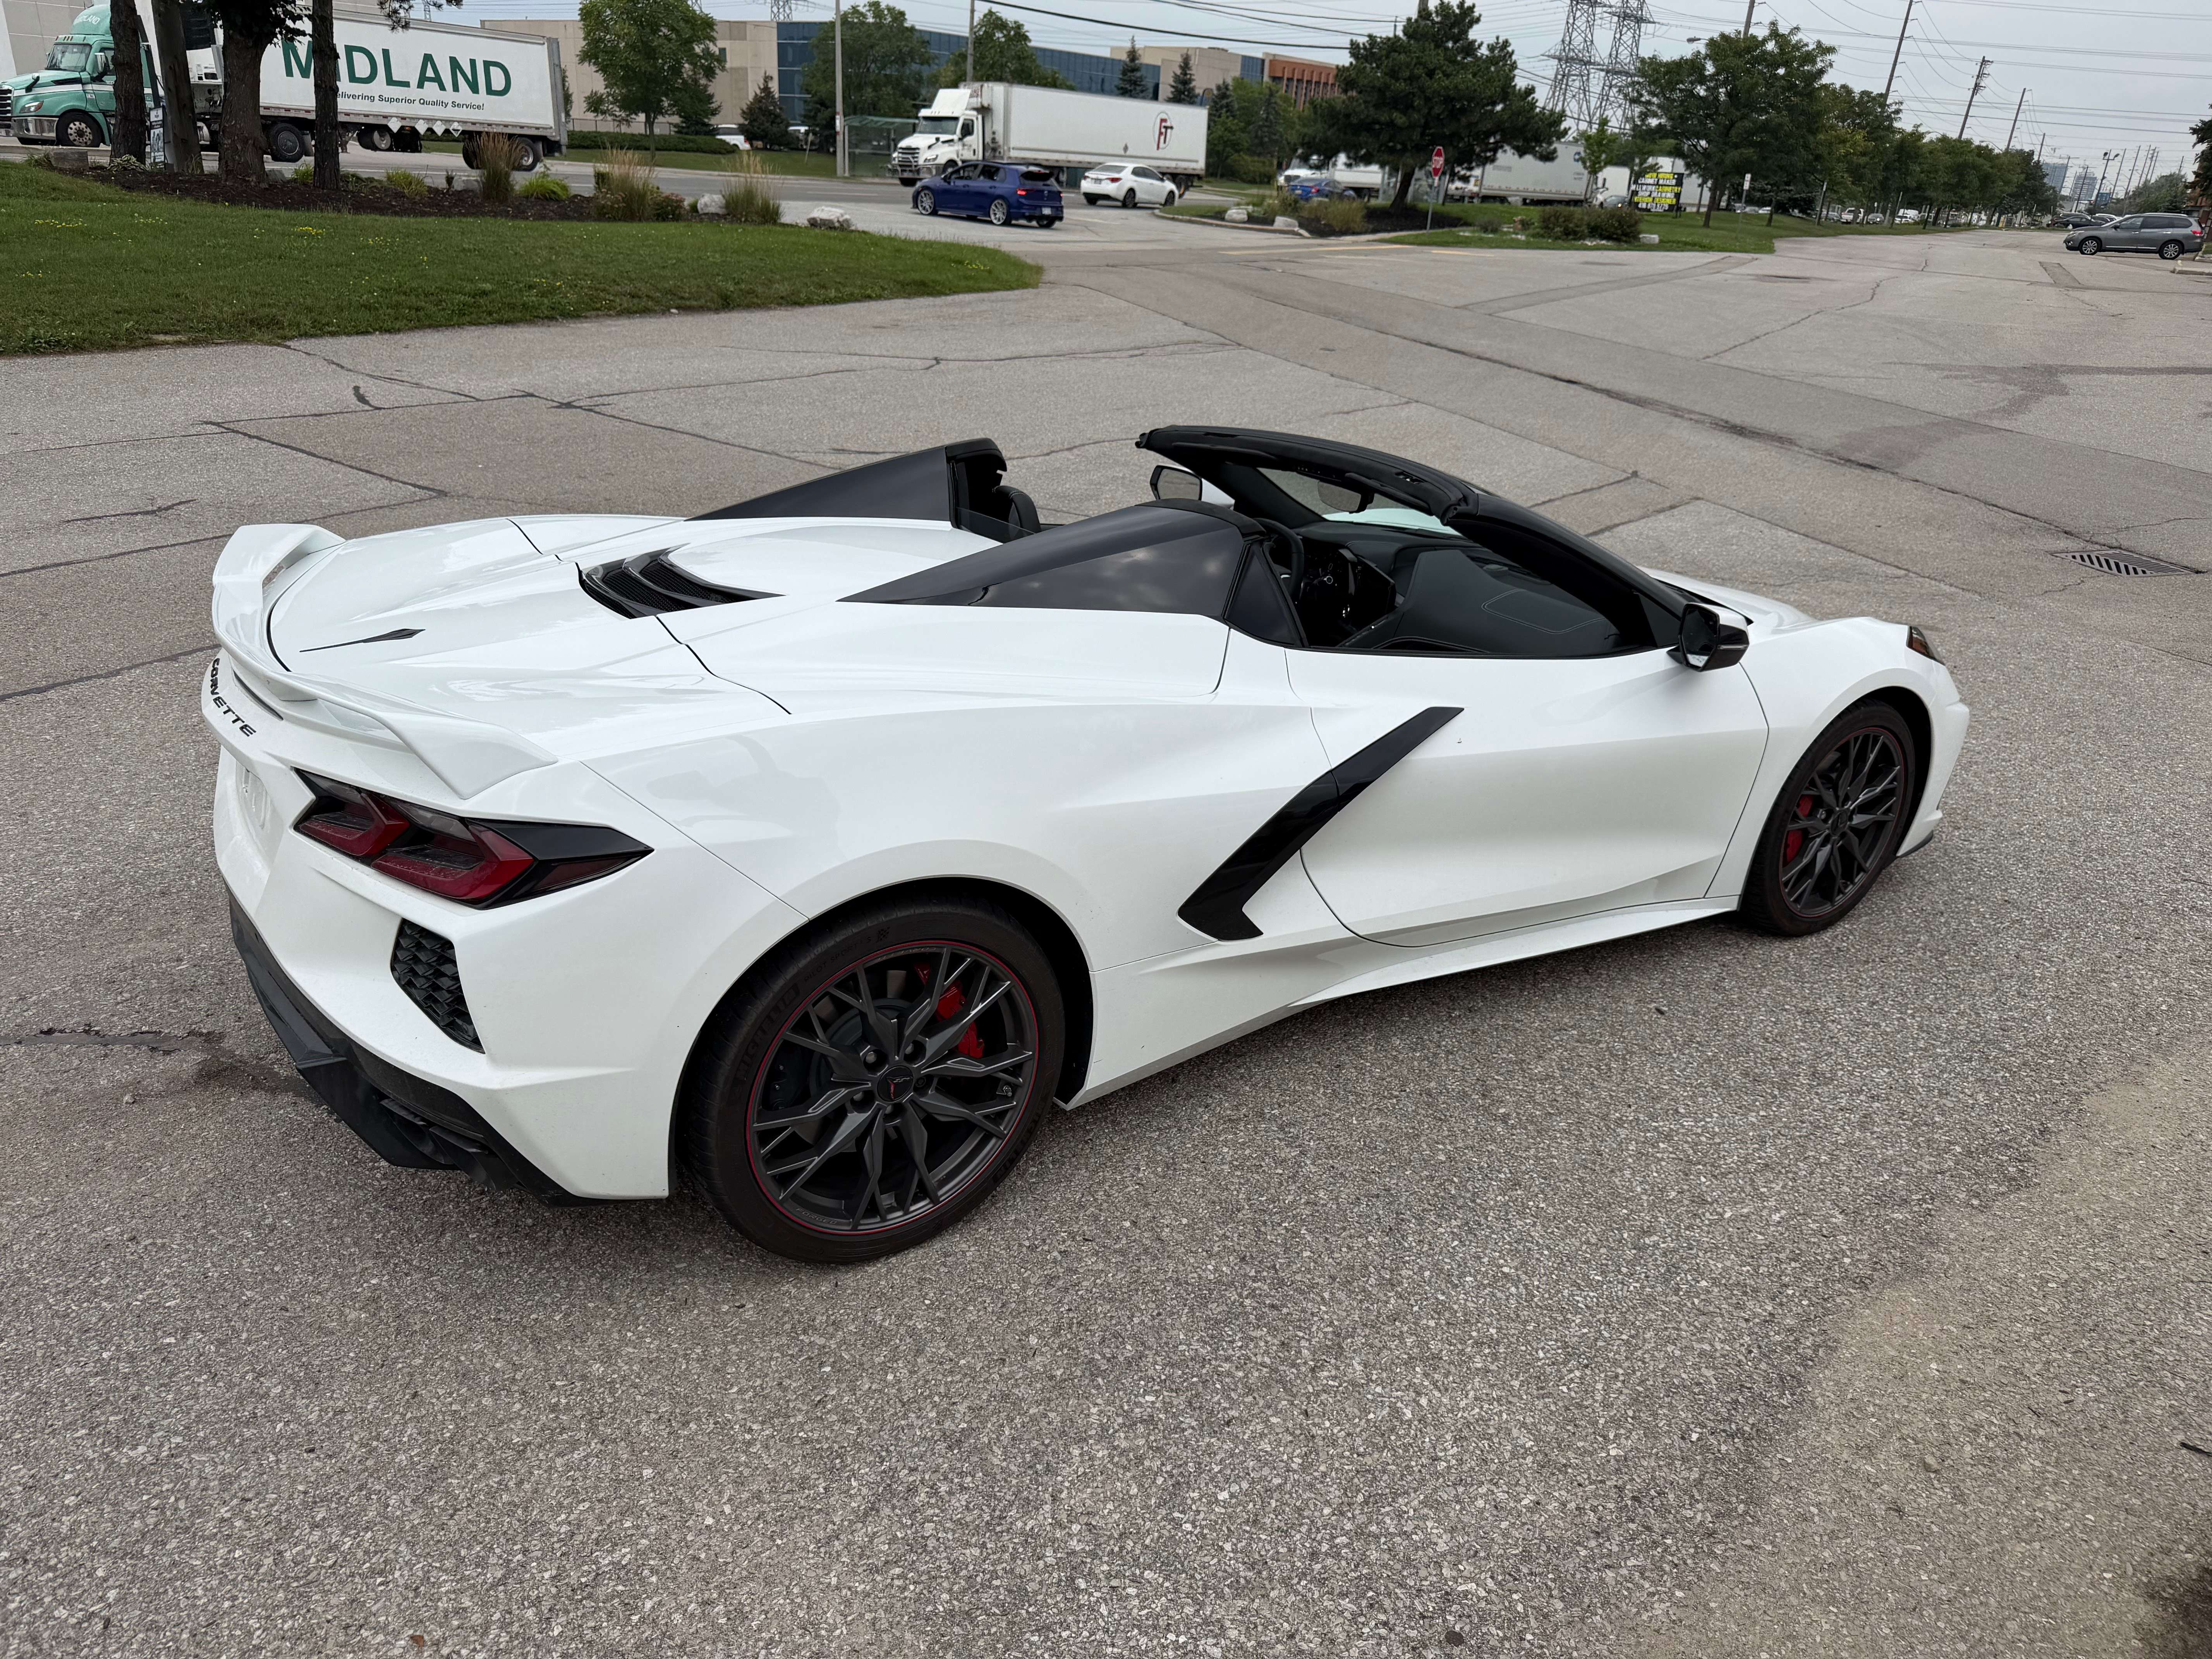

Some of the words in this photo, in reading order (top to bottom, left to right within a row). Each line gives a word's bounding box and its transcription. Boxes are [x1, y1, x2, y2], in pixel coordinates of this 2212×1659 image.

[337, 91, 375, 103] elivering
[378, 94, 416, 105] Superior
[419, 98, 448, 108] Quality
[451, 101, 484, 110] Service!
[1432, 156, 1444, 168] STOP
[210, 657, 257, 737] CORVETTE
[804, 962, 828, 982] PILOT
[830, 942, 859, 963] SPORT
[796, 1208, 837, 1224] FORGED
